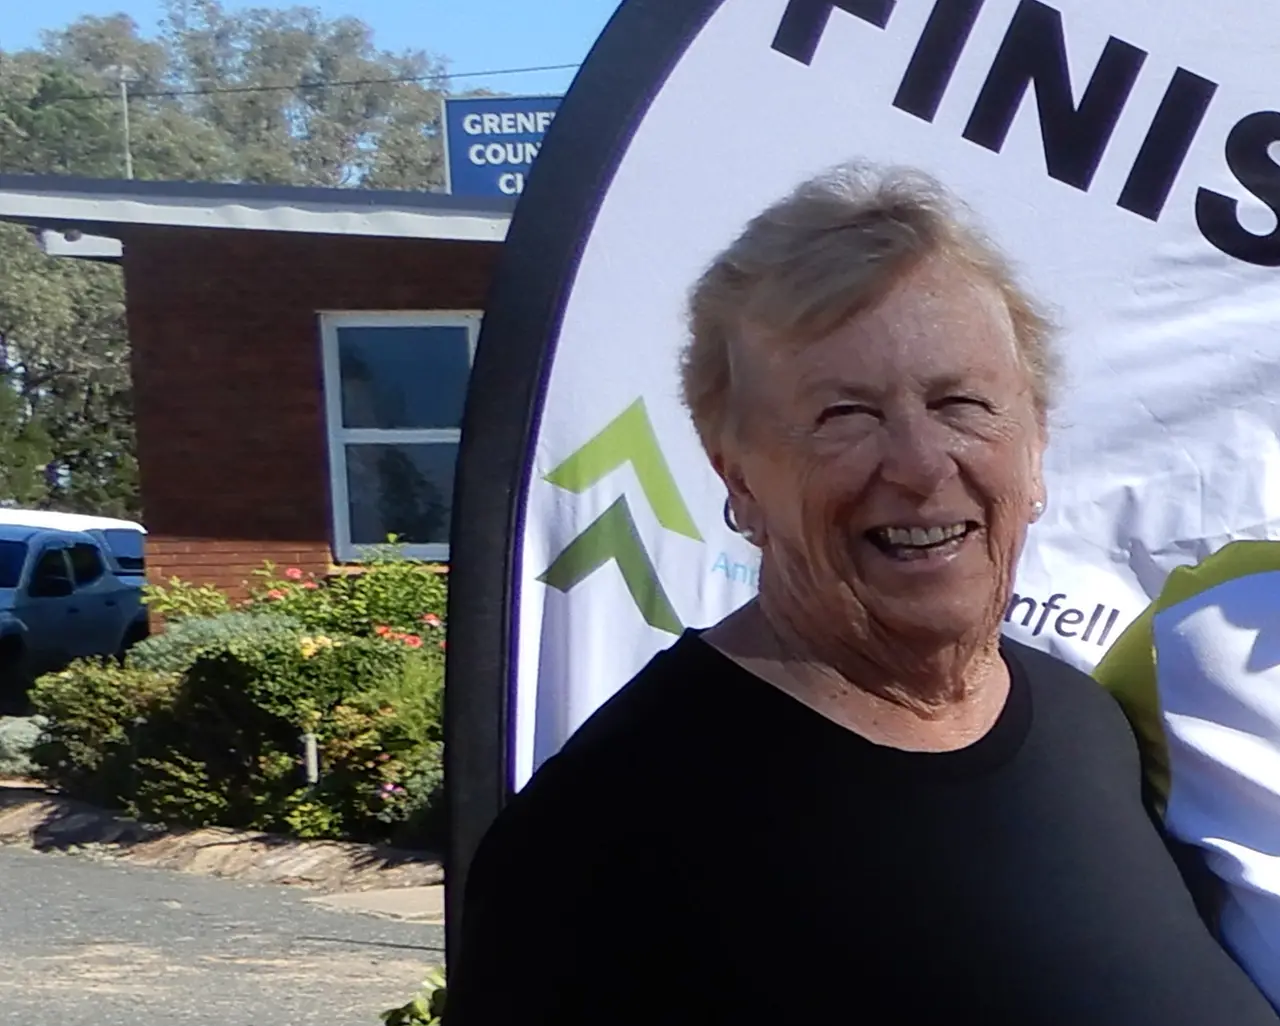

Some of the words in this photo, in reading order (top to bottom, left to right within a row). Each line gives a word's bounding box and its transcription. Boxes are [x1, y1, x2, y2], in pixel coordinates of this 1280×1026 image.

[463, 112, 556, 135] GRENF
[469, 142, 542, 165] COUN
[1004, 593, 1120, 646] nfell
